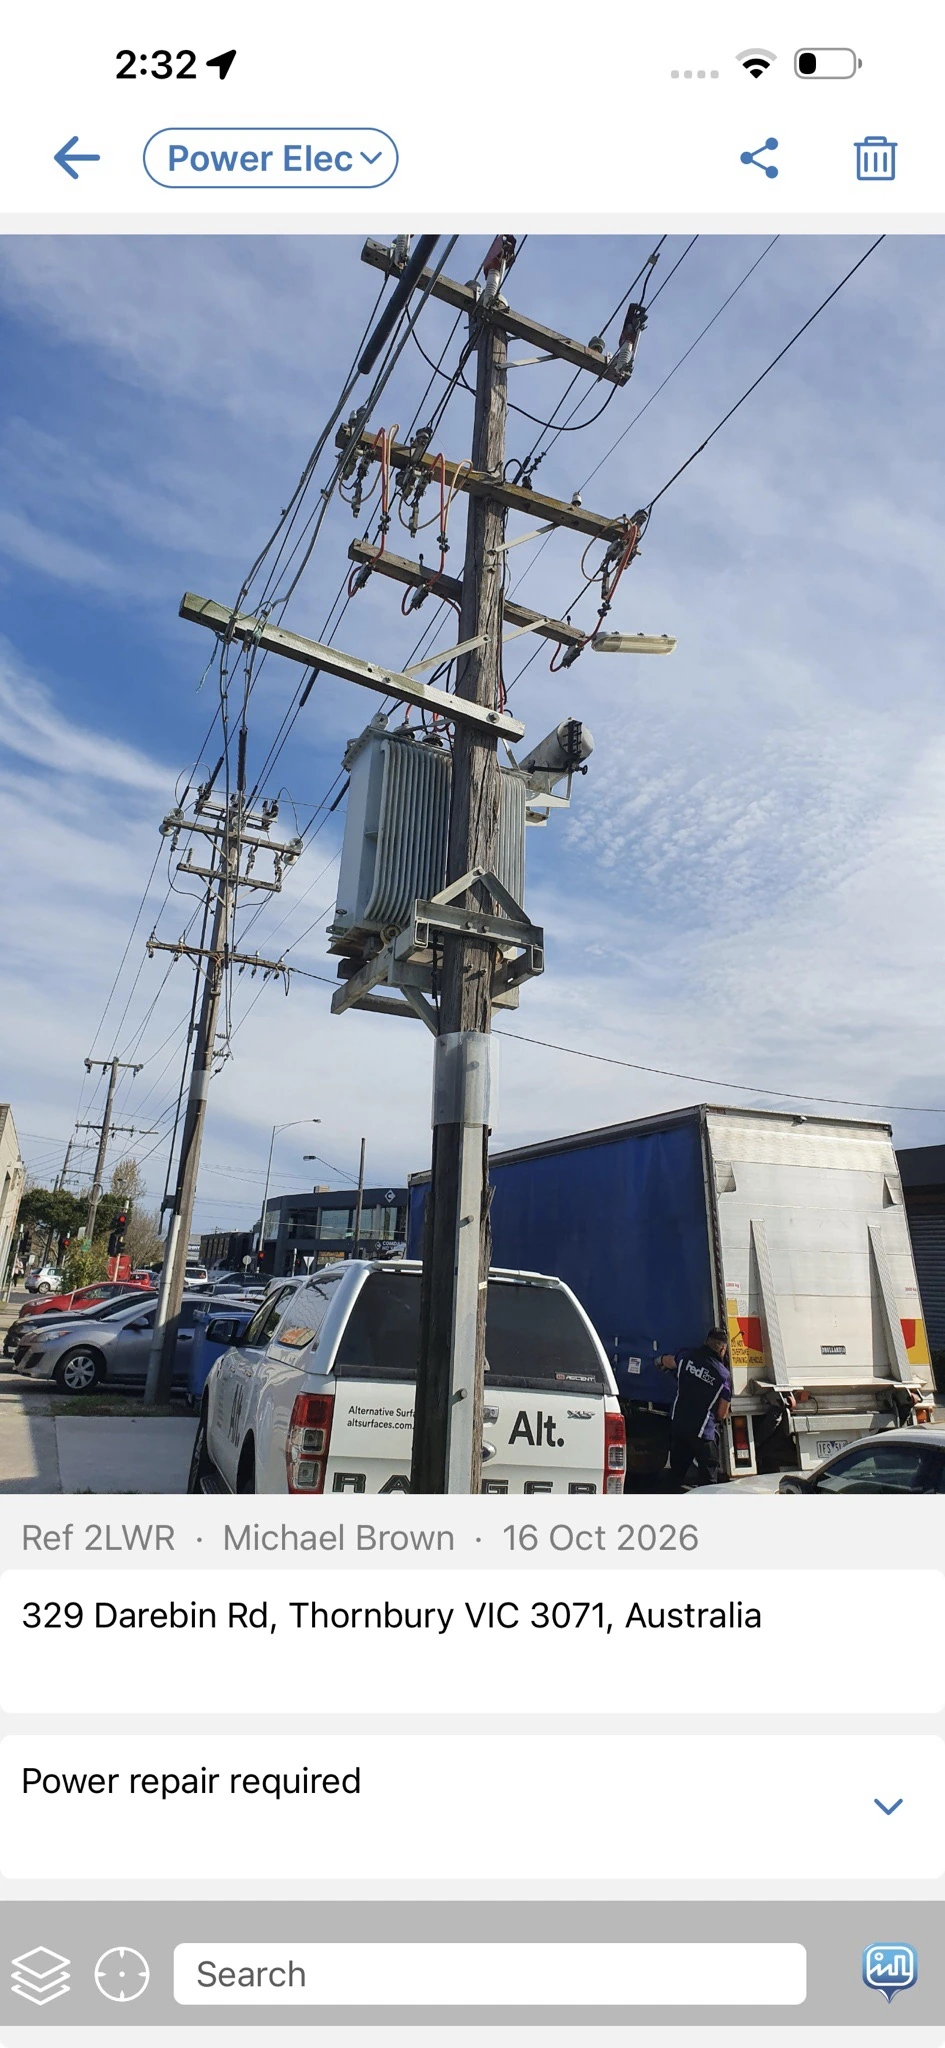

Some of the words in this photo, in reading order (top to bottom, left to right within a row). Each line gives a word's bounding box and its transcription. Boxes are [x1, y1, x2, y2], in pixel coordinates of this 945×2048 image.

[115, 49, 197, 80] 2:32
[168, 144, 274, 172] Power
[283, 144, 353, 172] Elec
[685, 1359, 716, 1386] FedEx
[348, 1405, 394, 1417] Alternative
[508, 1410, 565, 1448] Alt.
[332, 1472, 597, 1495] RAGER
[23, 1523, 74, 1551] Ref
[85, 1524, 175, 1551] 2LWR
[224, 1523, 344, 1551] Michael
[357, 1524, 454, 1551] Brown
[503, 1524, 538, 1551] 16
[549, 1524, 606, 1551] Oct
[617, 1523, 699, 1551] 2026
[22, 1601, 84, 1629] 329
[95, 1600, 216, 1629] Darebin
[228, 1600, 277, 1635] Rd,
[288, 1600, 455, 1635] Thornbury
[464, 1601, 519, 1629] VIC
[530, 1601, 613, 1635] 3071,
[624, 1600, 762, 1629] Australia
[22, 1767, 120, 1795] Power
[130, 1766, 220, 1801] repair
[230, 1766, 361, 1801] required
[197, 1959, 306, 1988] Search
